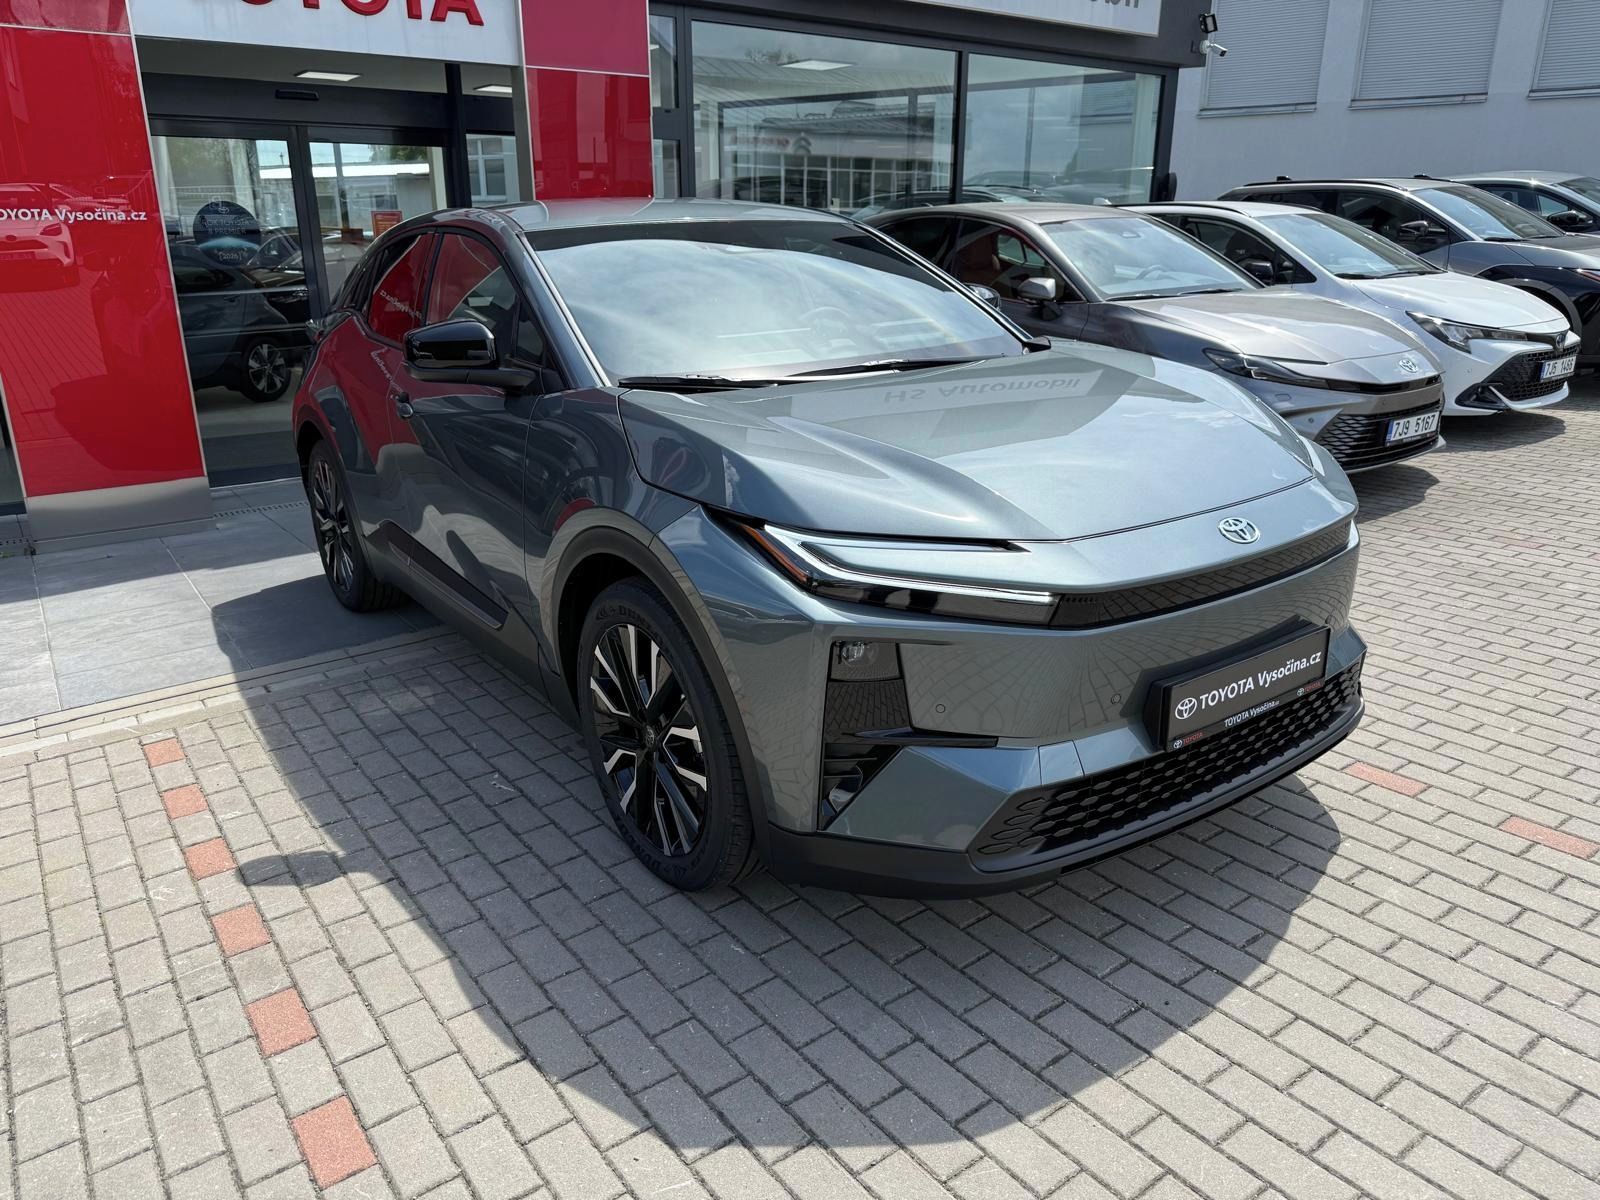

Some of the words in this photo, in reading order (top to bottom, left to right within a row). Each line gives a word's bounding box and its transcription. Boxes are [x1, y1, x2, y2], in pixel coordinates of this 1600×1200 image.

[0, 208, 53, 221] OYOTA
[55, 207, 147, 224] Vysočina.cz
[1393, 420, 1410, 438] 7J9
[1415, 414, 1436, 433] 5167
[1199, 676, 1255, 710] TOYOTA
[1257, 650, 1322, 688] Vysočina.cz
[1224, 711, 1249, 728] TOYOTA
[1183, 732, 1203, 744] TOYOTA
